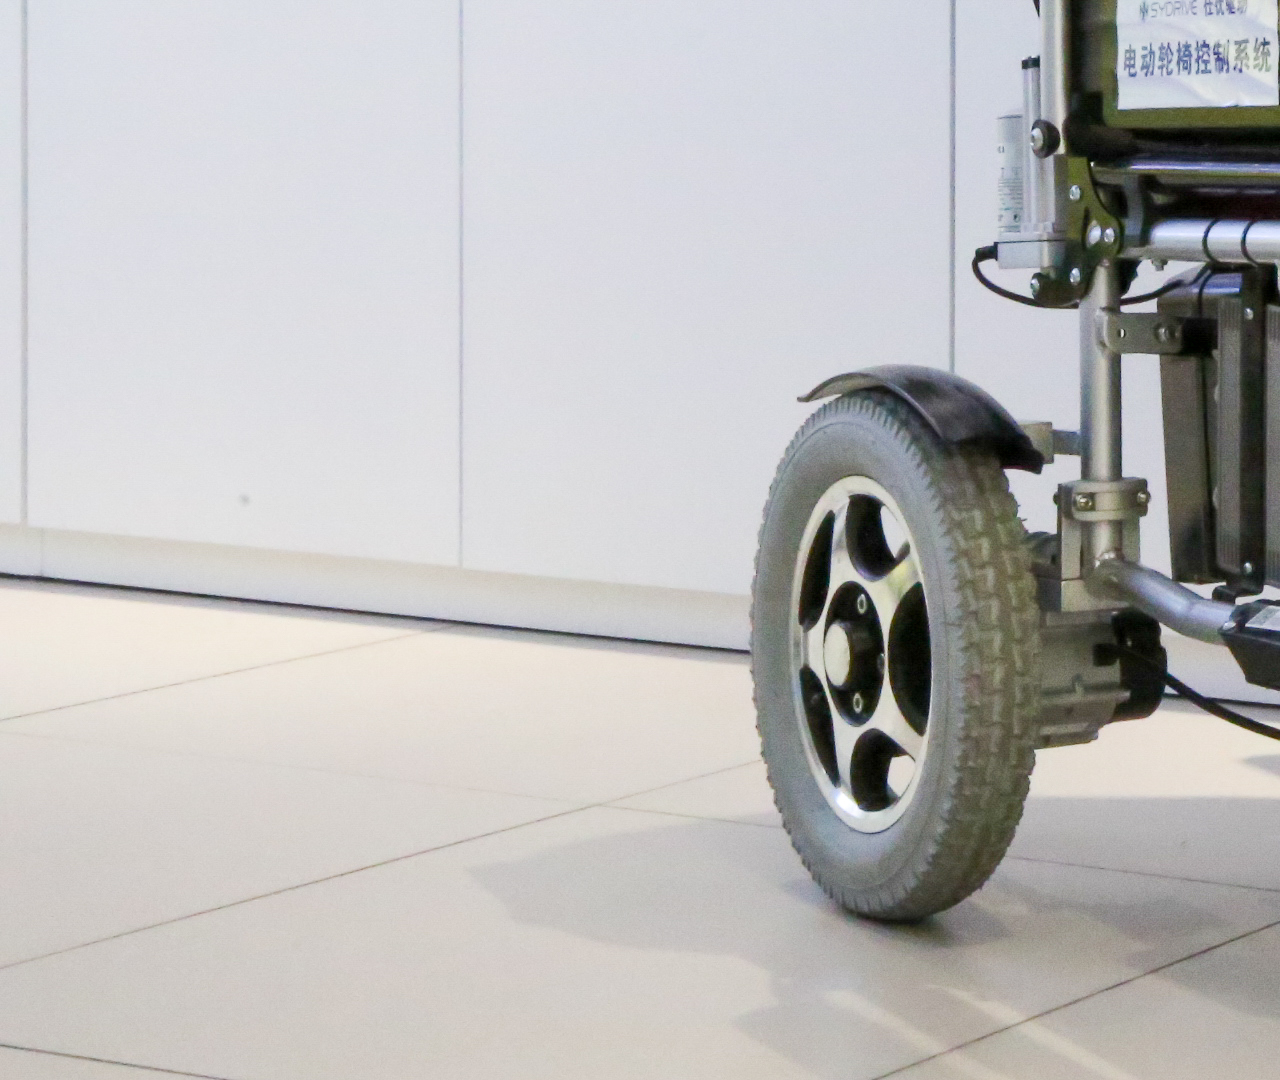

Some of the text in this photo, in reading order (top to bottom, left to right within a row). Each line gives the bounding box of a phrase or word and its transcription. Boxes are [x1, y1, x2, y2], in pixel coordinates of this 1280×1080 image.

[1123, 37, 1271, 77] 电动轮椅控制系统
